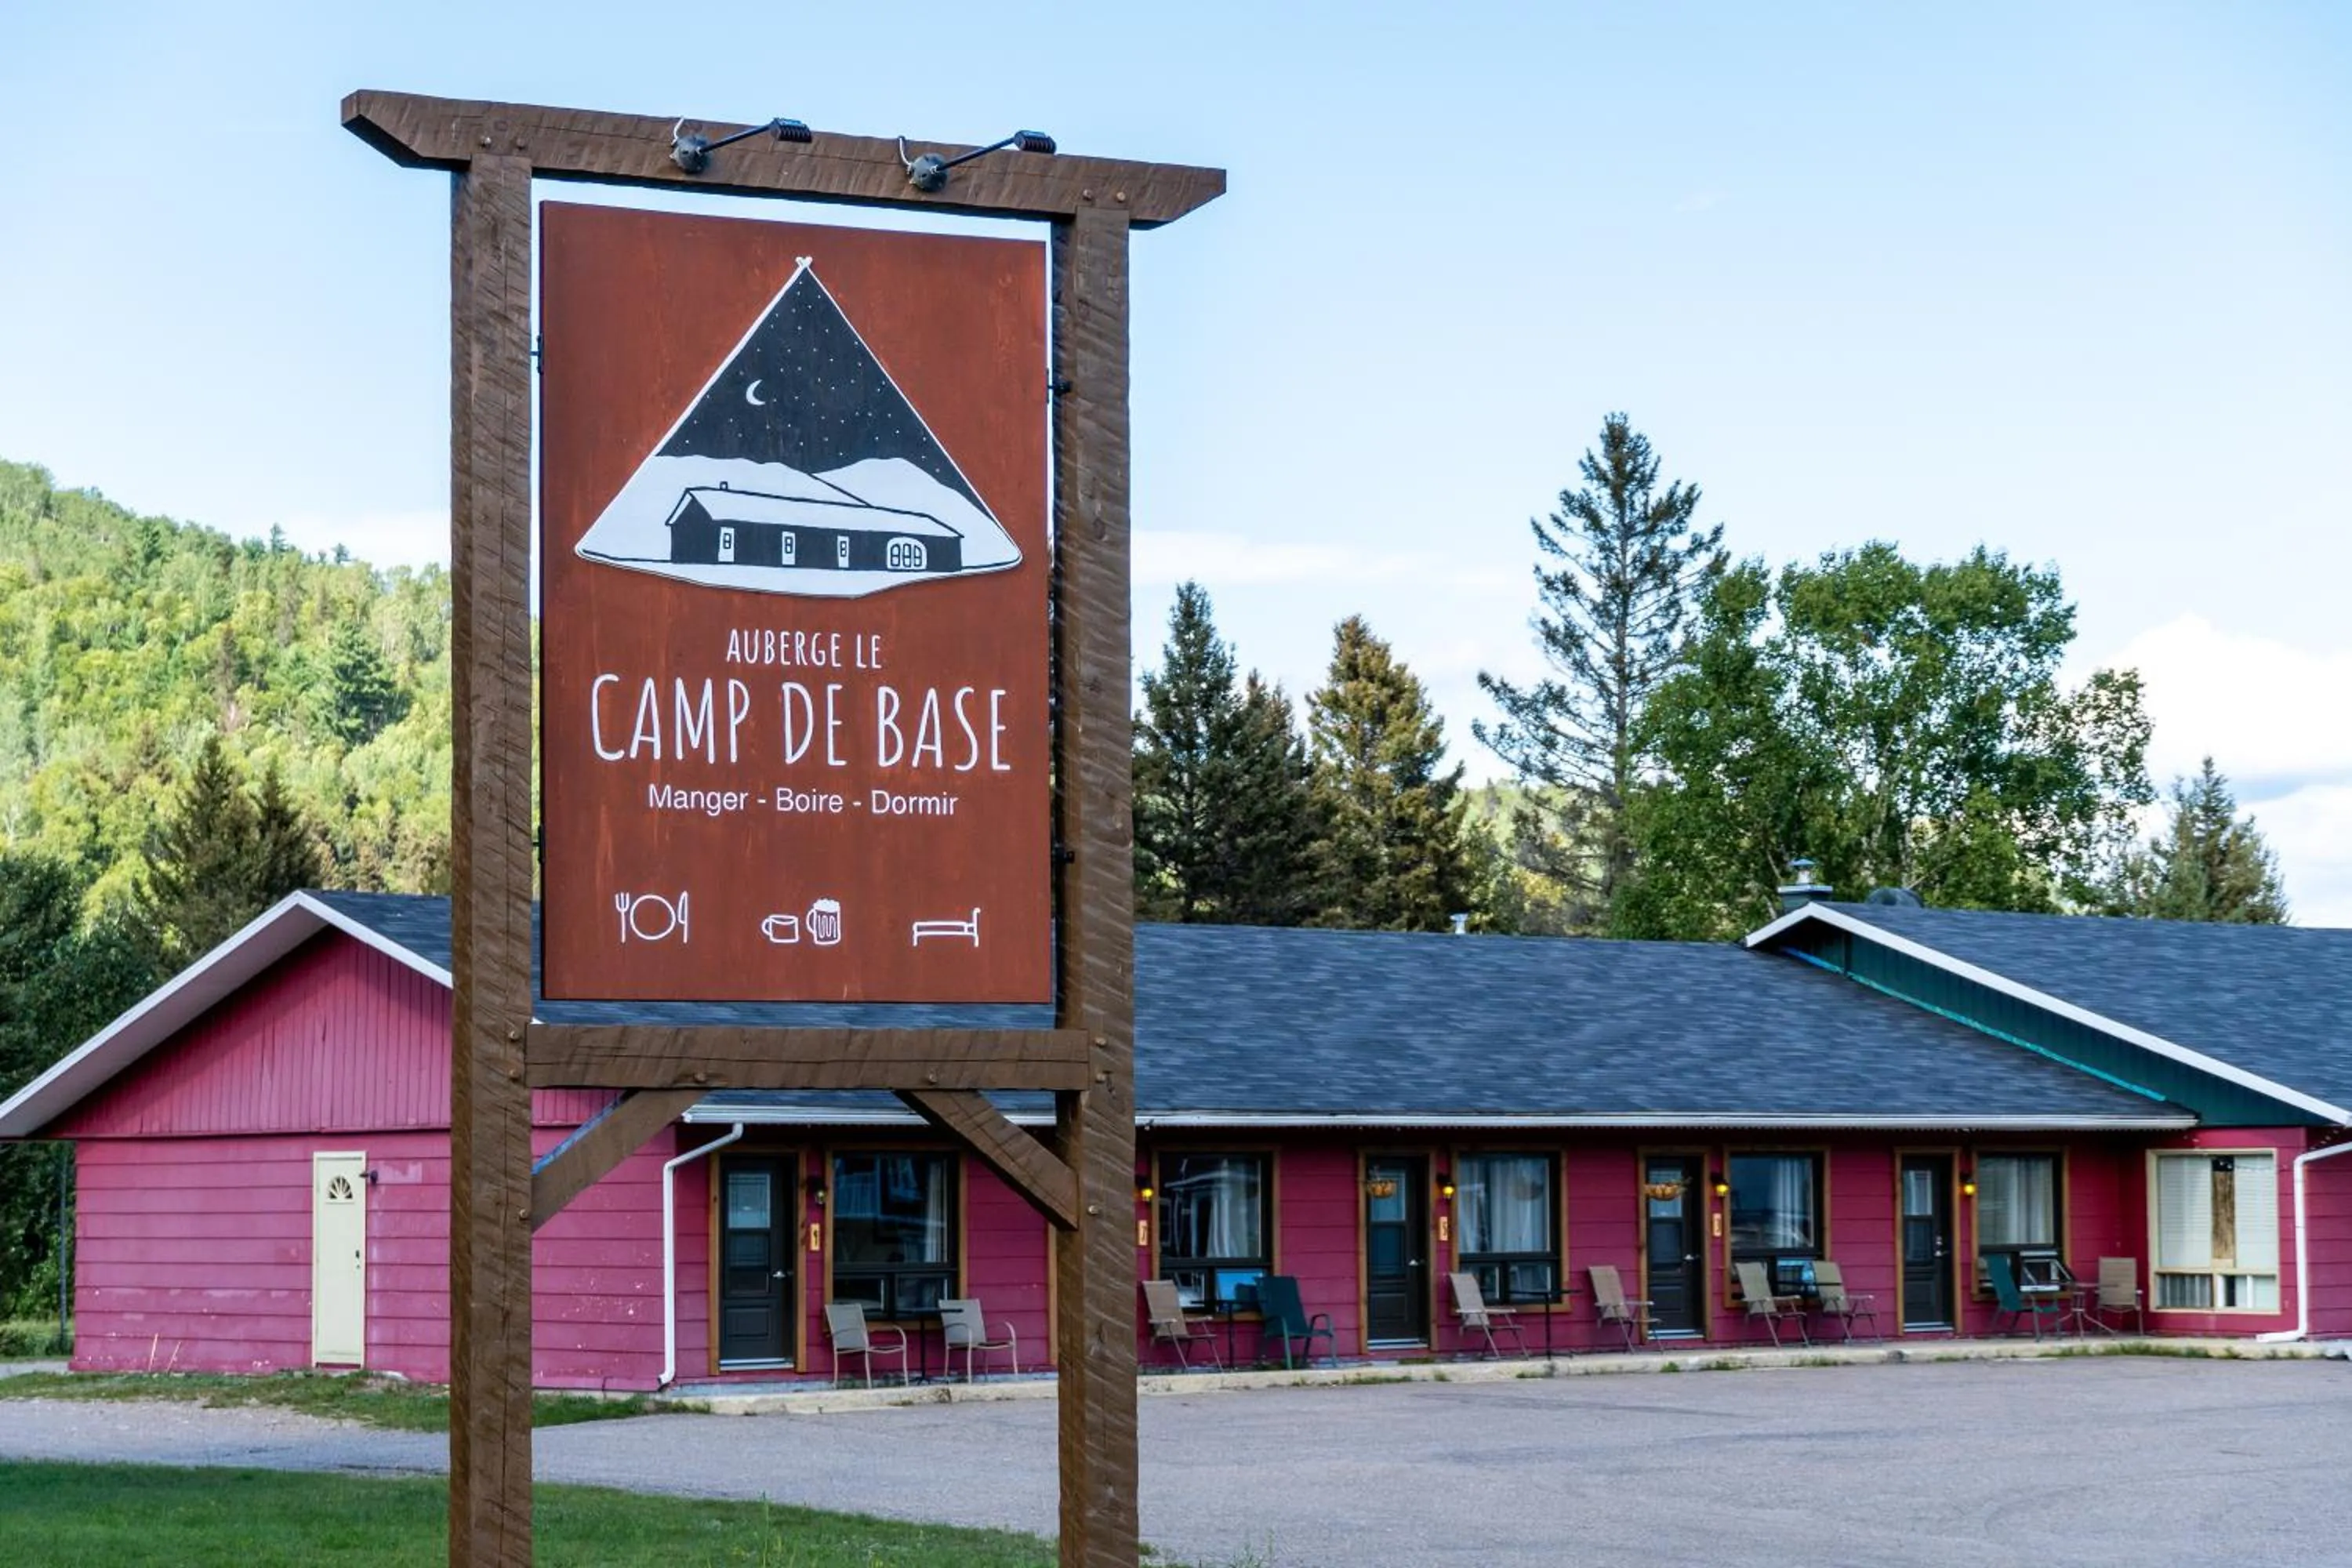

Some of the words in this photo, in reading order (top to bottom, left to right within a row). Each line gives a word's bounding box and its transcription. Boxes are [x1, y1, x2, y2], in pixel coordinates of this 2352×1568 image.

[727, 629, 842, 667] AUBERGE
[856, 633, 882, 669] LE
[592, 673, 750, 764] CAMP
[782, 681, 848, 766] DE
[877, 685, 1011, 771] BASE
[648, 784, 749, 817] Manger
[776, 787, 844, 813] Boire
[871, 789, 958, 816] Dormir
